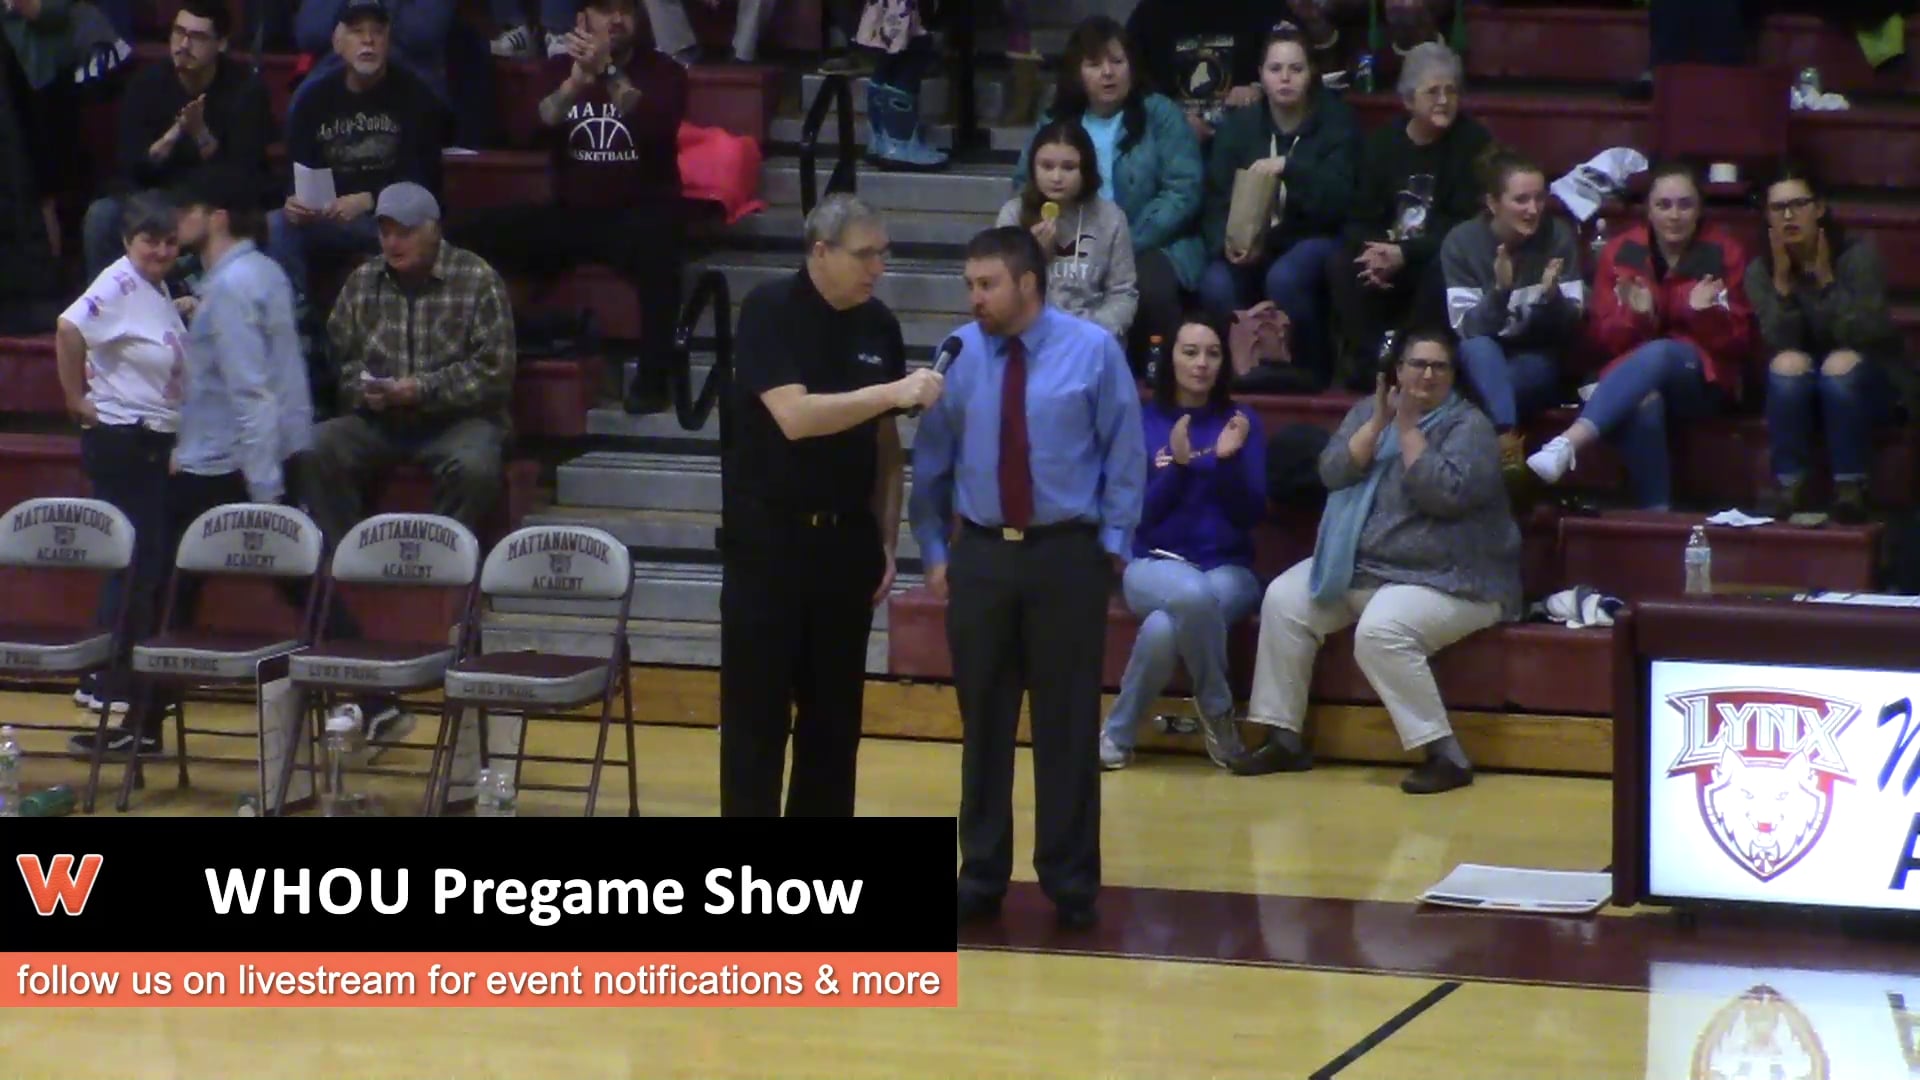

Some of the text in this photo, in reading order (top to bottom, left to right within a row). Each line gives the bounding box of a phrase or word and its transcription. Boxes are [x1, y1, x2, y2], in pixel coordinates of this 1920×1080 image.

[12, 503, 115, 537] MATTANAWCOOK
[202, 508, 303, 543] MATTANAWCOOK
[358, 518, 460, 552] MATTANAWCOOK
[36, 548, 88, 562] ACADEMY
[224, 552, 277, 568] ACADEMY
[507, 530, 611, 565] MATTANAWCOOK
[381, 564, 434, 579] ACADEMY
[531, 575, 584, 591] ACADEMY
[1670, 692, 1860, 774] LYNX
